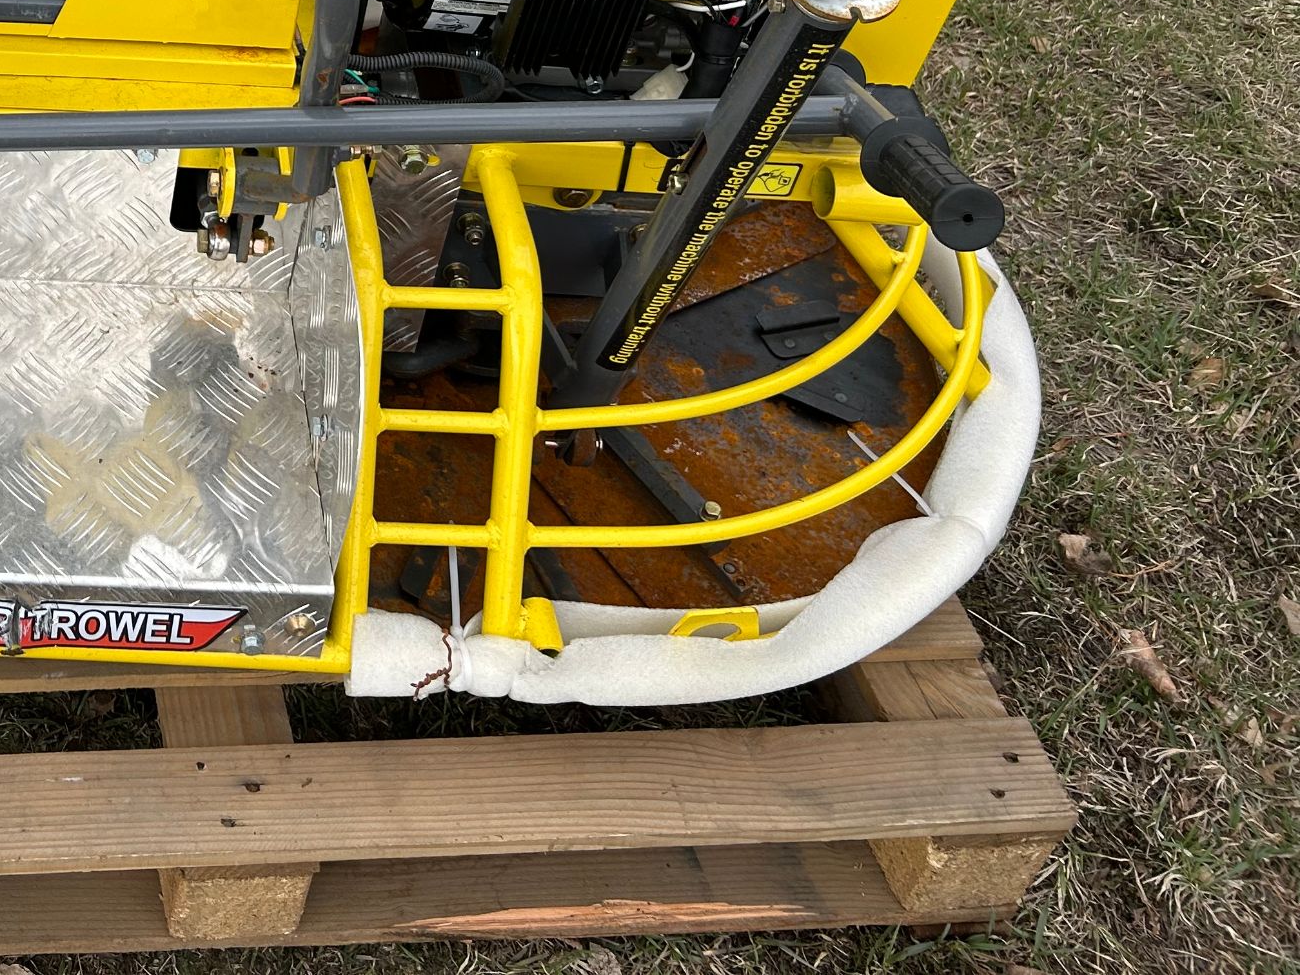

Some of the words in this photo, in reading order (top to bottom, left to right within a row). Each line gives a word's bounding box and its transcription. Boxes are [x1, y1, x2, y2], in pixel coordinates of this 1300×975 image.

[798, 58, 827, 72] is
[807, 43, 836, 61] It
[754, 73, 816, 141] forbidden
[744, 143, 770, 159] to
[712, 160, 755, 209] operate
[698, 210, 727, 232] the
[666, 232, 710, 282] machine
[638, 282, 678, 324] without
[608, 325, 653, 365] training
[28, 605, 194, 645] TROWEL
